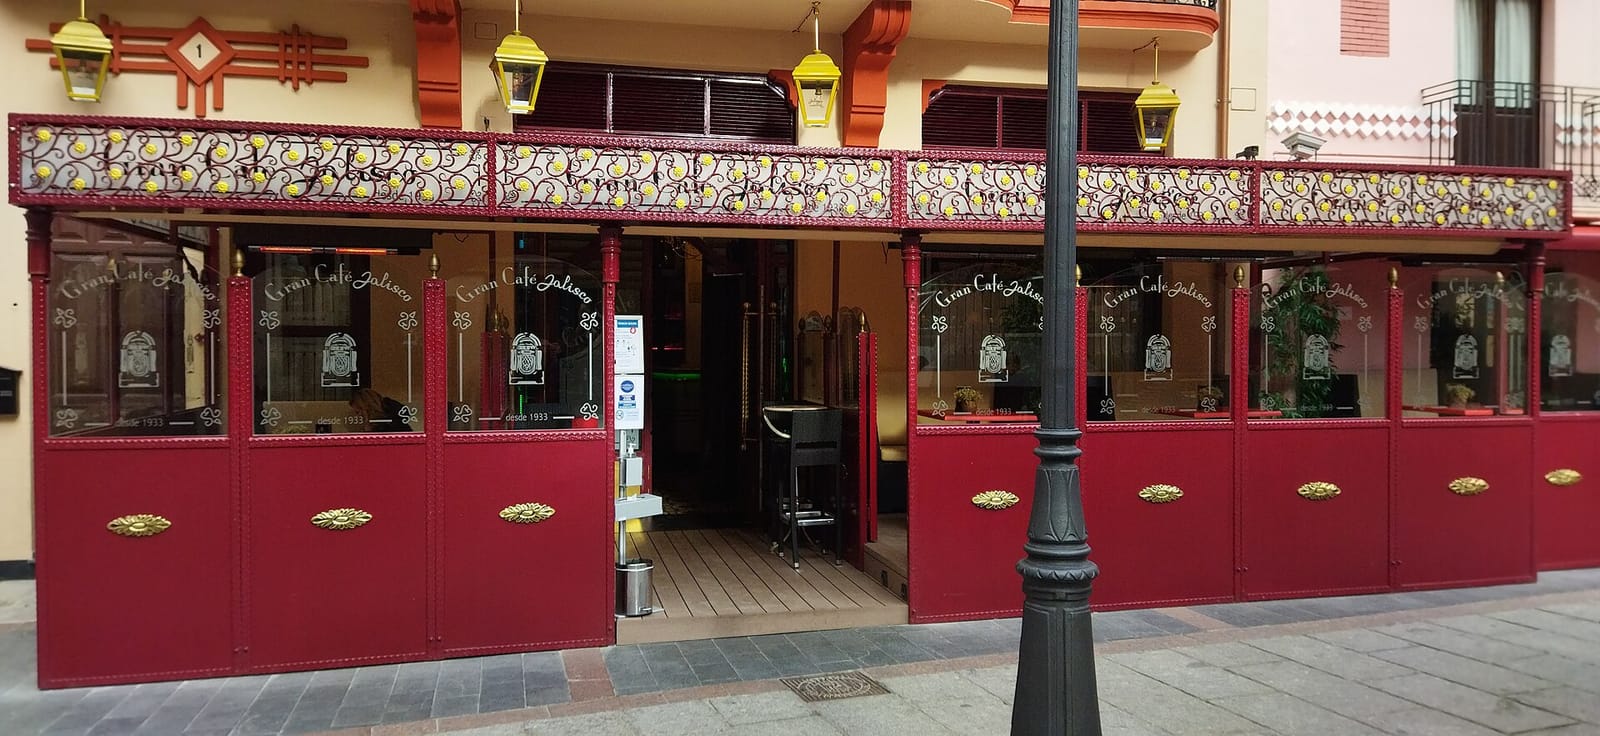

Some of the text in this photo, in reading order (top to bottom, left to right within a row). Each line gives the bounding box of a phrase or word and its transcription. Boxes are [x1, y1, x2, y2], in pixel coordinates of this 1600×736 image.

[196, 43, 202, 58] 1
[60, 260, 216, 301] Gran Café Jaco
[264, 263, 412, 302] Gran Café Jalisco
[455, 280, 499, 303] Gran
[502, 266, 537, 287] Café
[536, 274, 592, 304] Jalisco
[935, 273, 1044, 308] Gran Café Jalisc
[1103, 275, 1212, 308] Gran Café Jalisco
[1262, 276, 1368, 309] Gran Café Jalisco
[1416, 290, 1448, 309] Gran
[317, 416, 364, 425] desde 1933
[505, 412, 548, 422] desde 1933
